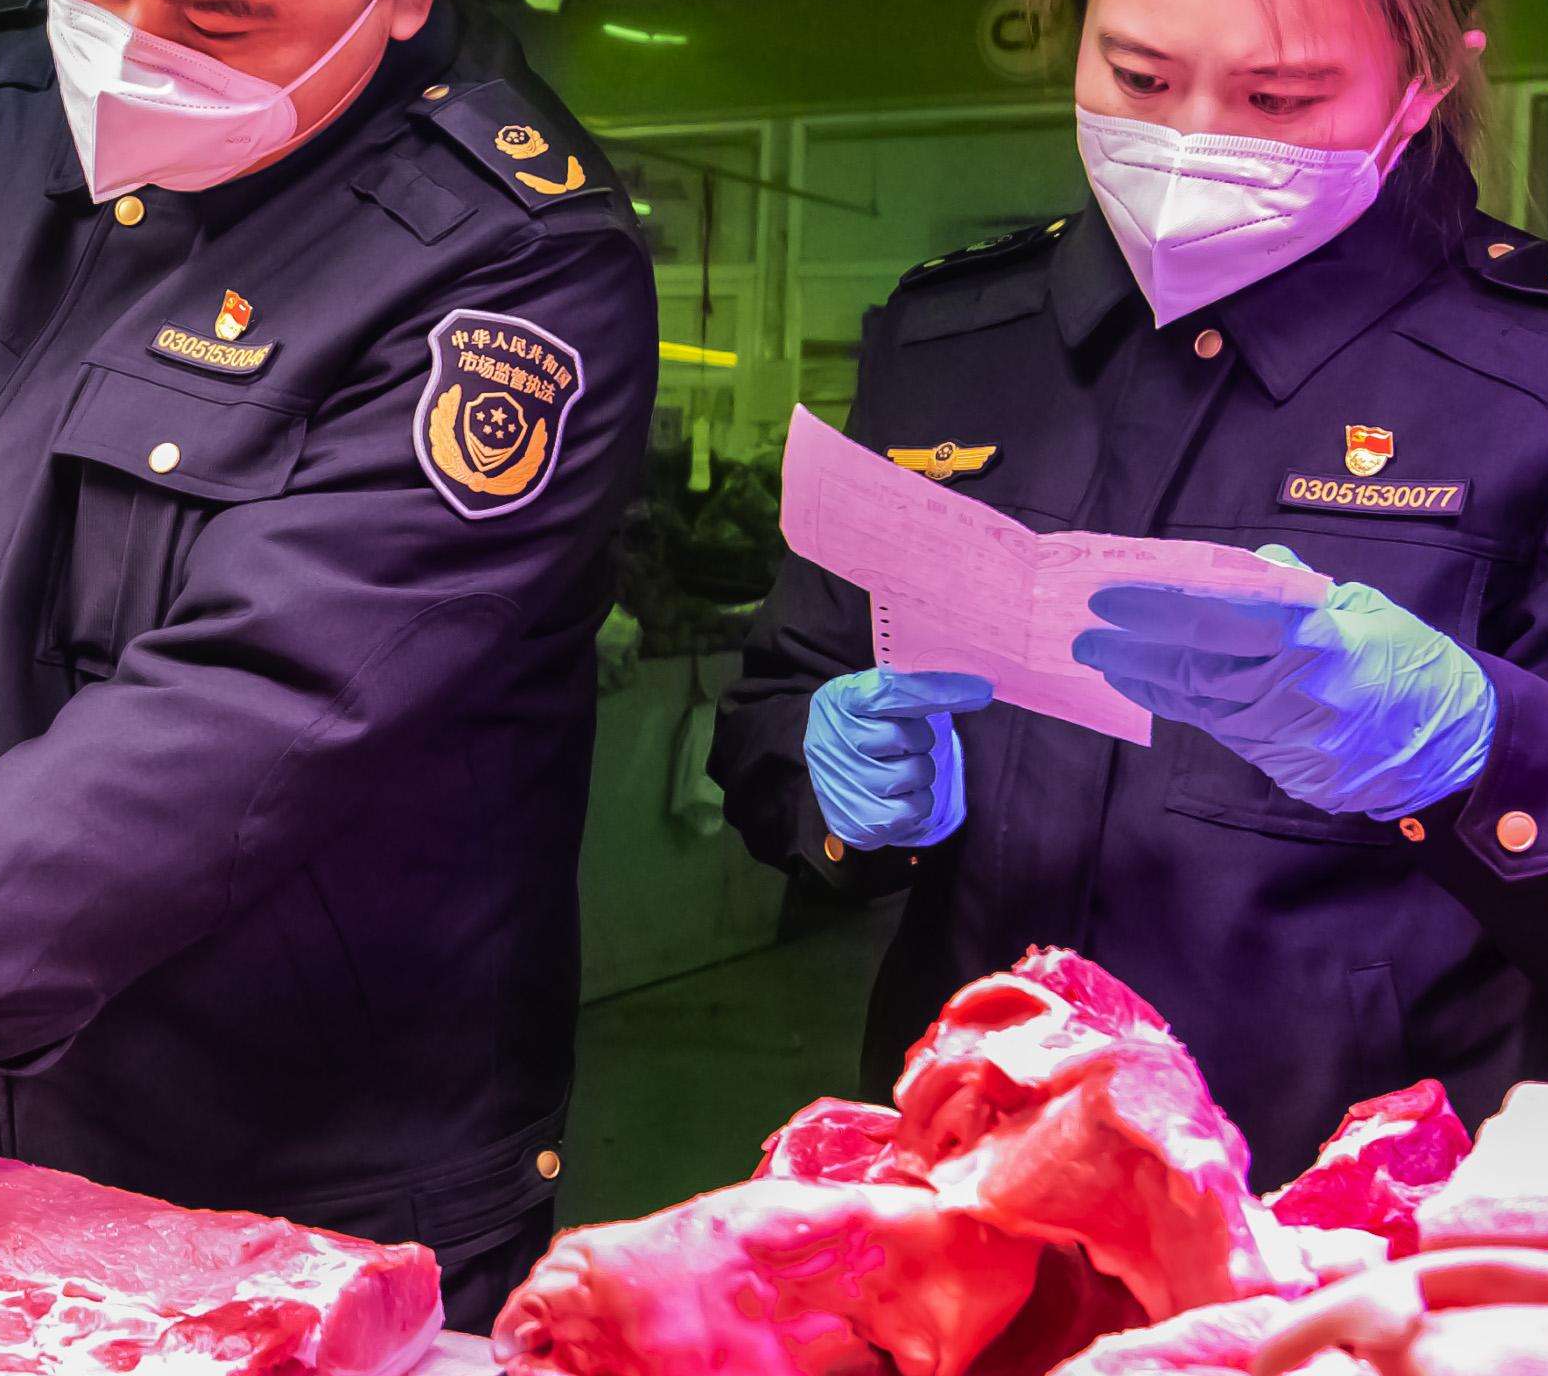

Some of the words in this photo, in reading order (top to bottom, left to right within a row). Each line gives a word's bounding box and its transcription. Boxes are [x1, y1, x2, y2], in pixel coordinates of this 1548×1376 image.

[451, 328, 573, 390] 中华人民共和国
[457, 350, 557, 405] 市场监管执法
[1289, 476, 1459, 509] 03051530077
